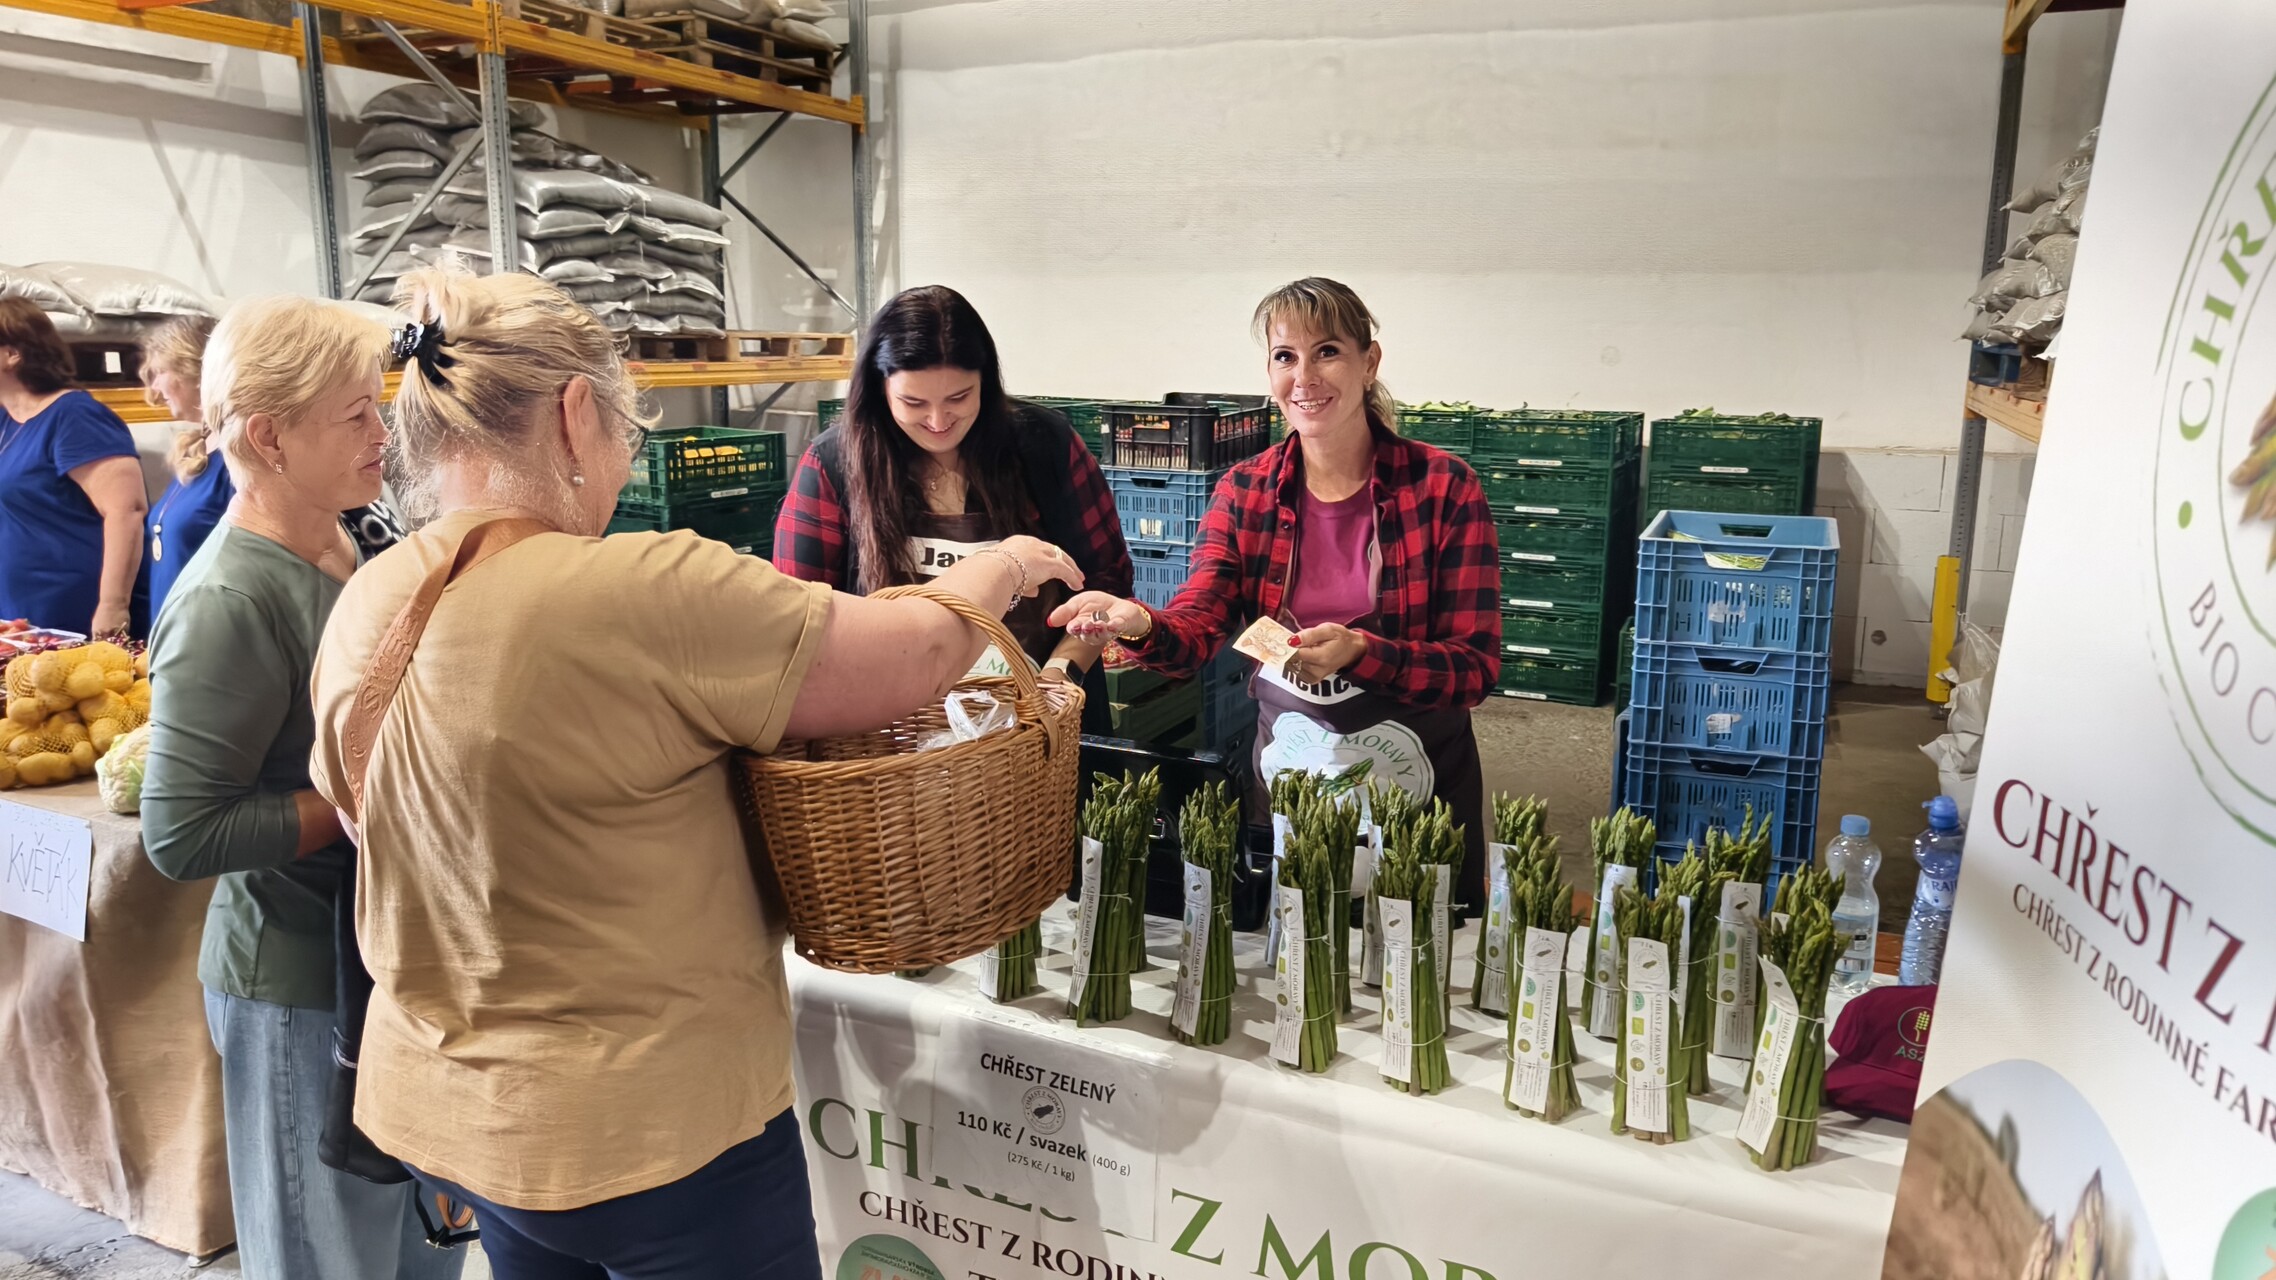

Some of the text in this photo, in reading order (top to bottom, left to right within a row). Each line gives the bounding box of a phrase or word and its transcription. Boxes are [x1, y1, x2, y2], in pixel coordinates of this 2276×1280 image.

[920, 547, 967, 568] Ja
[2190, 580, 2239, 697] BIO
[1339, 734, 1416, 777] MORAVY
[6, 831, 81, 919] KVĚTÁK
[1993, 779, 2194, 975] CHŘEST
[2194, 917, 2245, 1026] Z
[2013, 883, 2087, 964] CHŘEST
[2086, 944, 2102, 982] Z
[2102, 961, 2210, 1088] RODINNÉ
[980, 1053, 1116, 1104] CHŘEST ZELENÝ
[957, 1110, 987, 1132] 110
[993, 1120, 1012, 1139] Kč
[1015, 1126, 1025, 1145] /
[1029, 1134, 1086, 1161] svazek
[1092, 1154, 1118, 1171] (400
[1120, 1163, 1131, 1177] g)
[1007, 1151, 1075, 1182] (275 Kč / 1 kg)
[859, 1190, 993, 1250] CHŘEST
[1001, 1230, 1022, 1260] Z
[1170, 1188, 1225, 1266] Z
